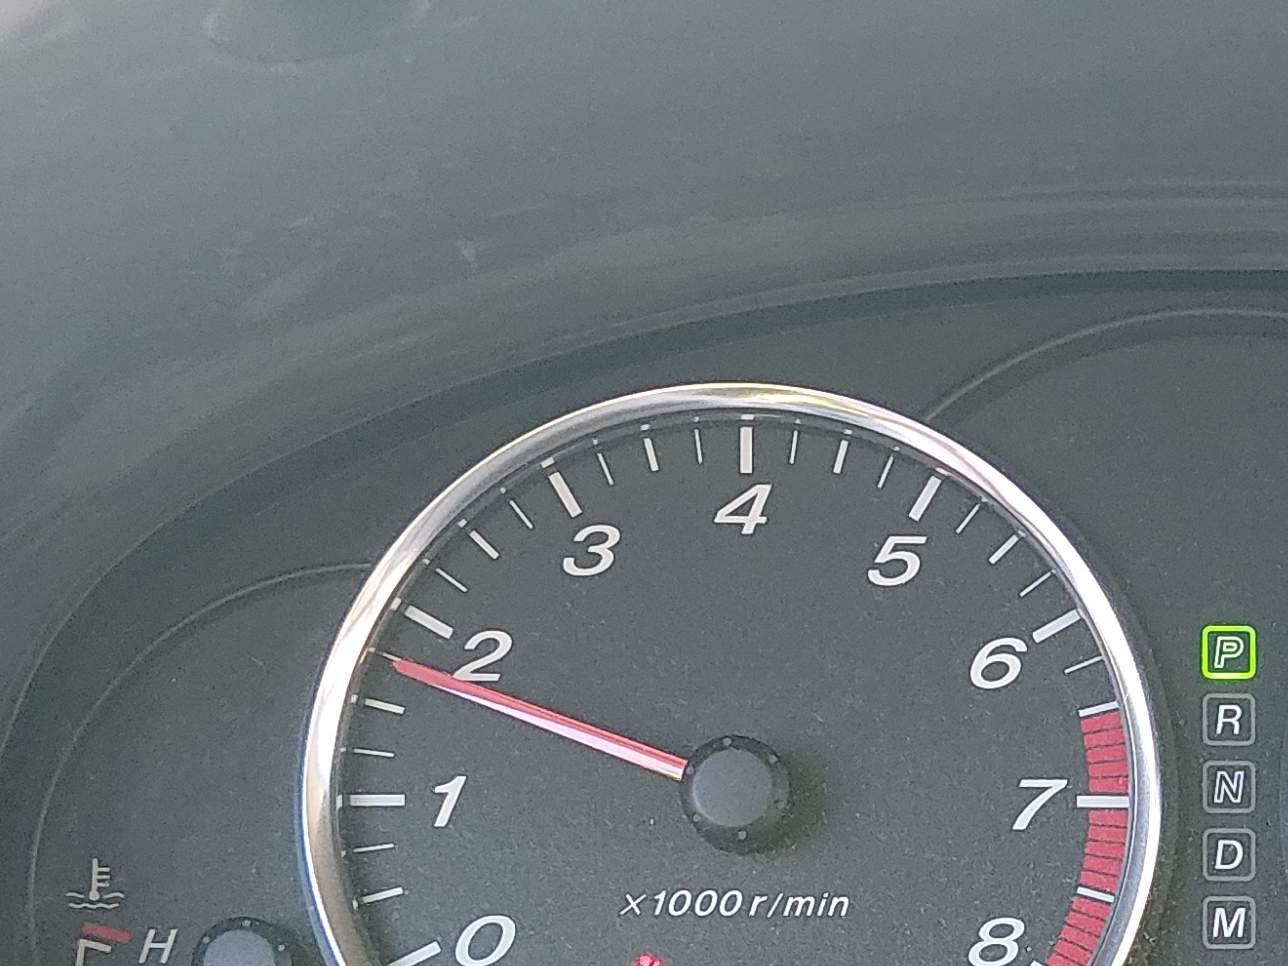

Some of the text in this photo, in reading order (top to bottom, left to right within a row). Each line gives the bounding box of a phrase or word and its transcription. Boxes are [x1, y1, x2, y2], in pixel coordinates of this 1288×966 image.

[713, 484, 772, 535] 4
[562, 524, 621, 576] 3
[867, 535, 927, 586] 5
[453, 630, 513, 683] 2
[970, 637, 1028, 689] 6
[1213, 636, 1244, 669] P
[1216, 704, 1242, 735] R
[434, 775, 467, 827] 1
[1012, 779, 1068, 830] 7
[1214, 770, 1245, 804] N
[1214, 839, 1244, 870] D
[749, 892, 849, 918] r/min
[1212, 907, 1246, 938] M
[138, 928, 178, 964] H
